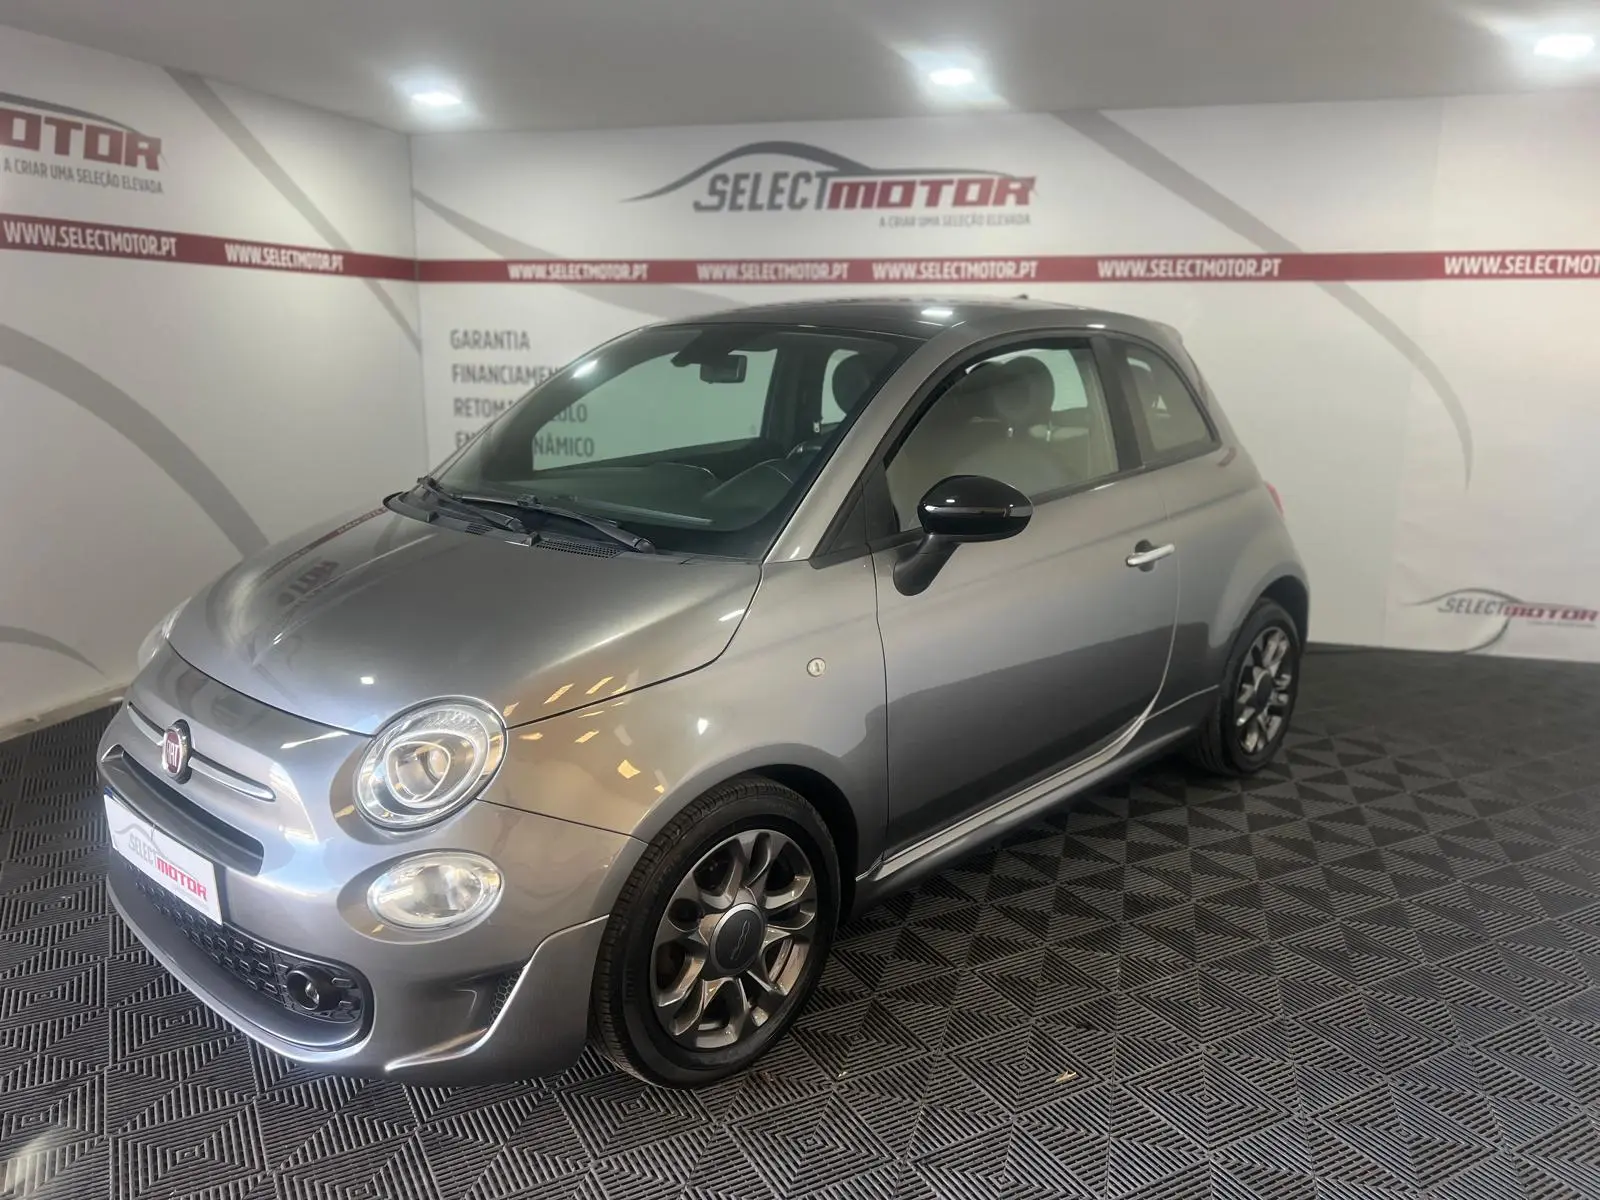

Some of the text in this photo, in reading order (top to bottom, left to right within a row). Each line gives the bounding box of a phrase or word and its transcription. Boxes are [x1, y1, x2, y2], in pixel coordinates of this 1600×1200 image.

[4, 157, 164, 194] A CRIAR UMA SELEÇÃO ELEVADA
[3, 220, 344, 272] WWW.SELECTMOTOR.PT WWW.SELECTMOTOR.PT
[507, 263, 649, 280] WWW.SELECTMOTOR.PT
[696, 262, 849, 280] WWW.SELECTMOTOR.PT
[872, 261, 1038, 279] WWW.SELECTMOTOR.PT
[1097, 258, 1282, 277] WWW.SELECTMOTOR.PT
[450, 329, 531, 351] GARANTIA
[451, 363, 562, 387] FINANCIAME
[453, 397, 516, 419] RETOM
[533, 432, 596, 457] NÂMICO
